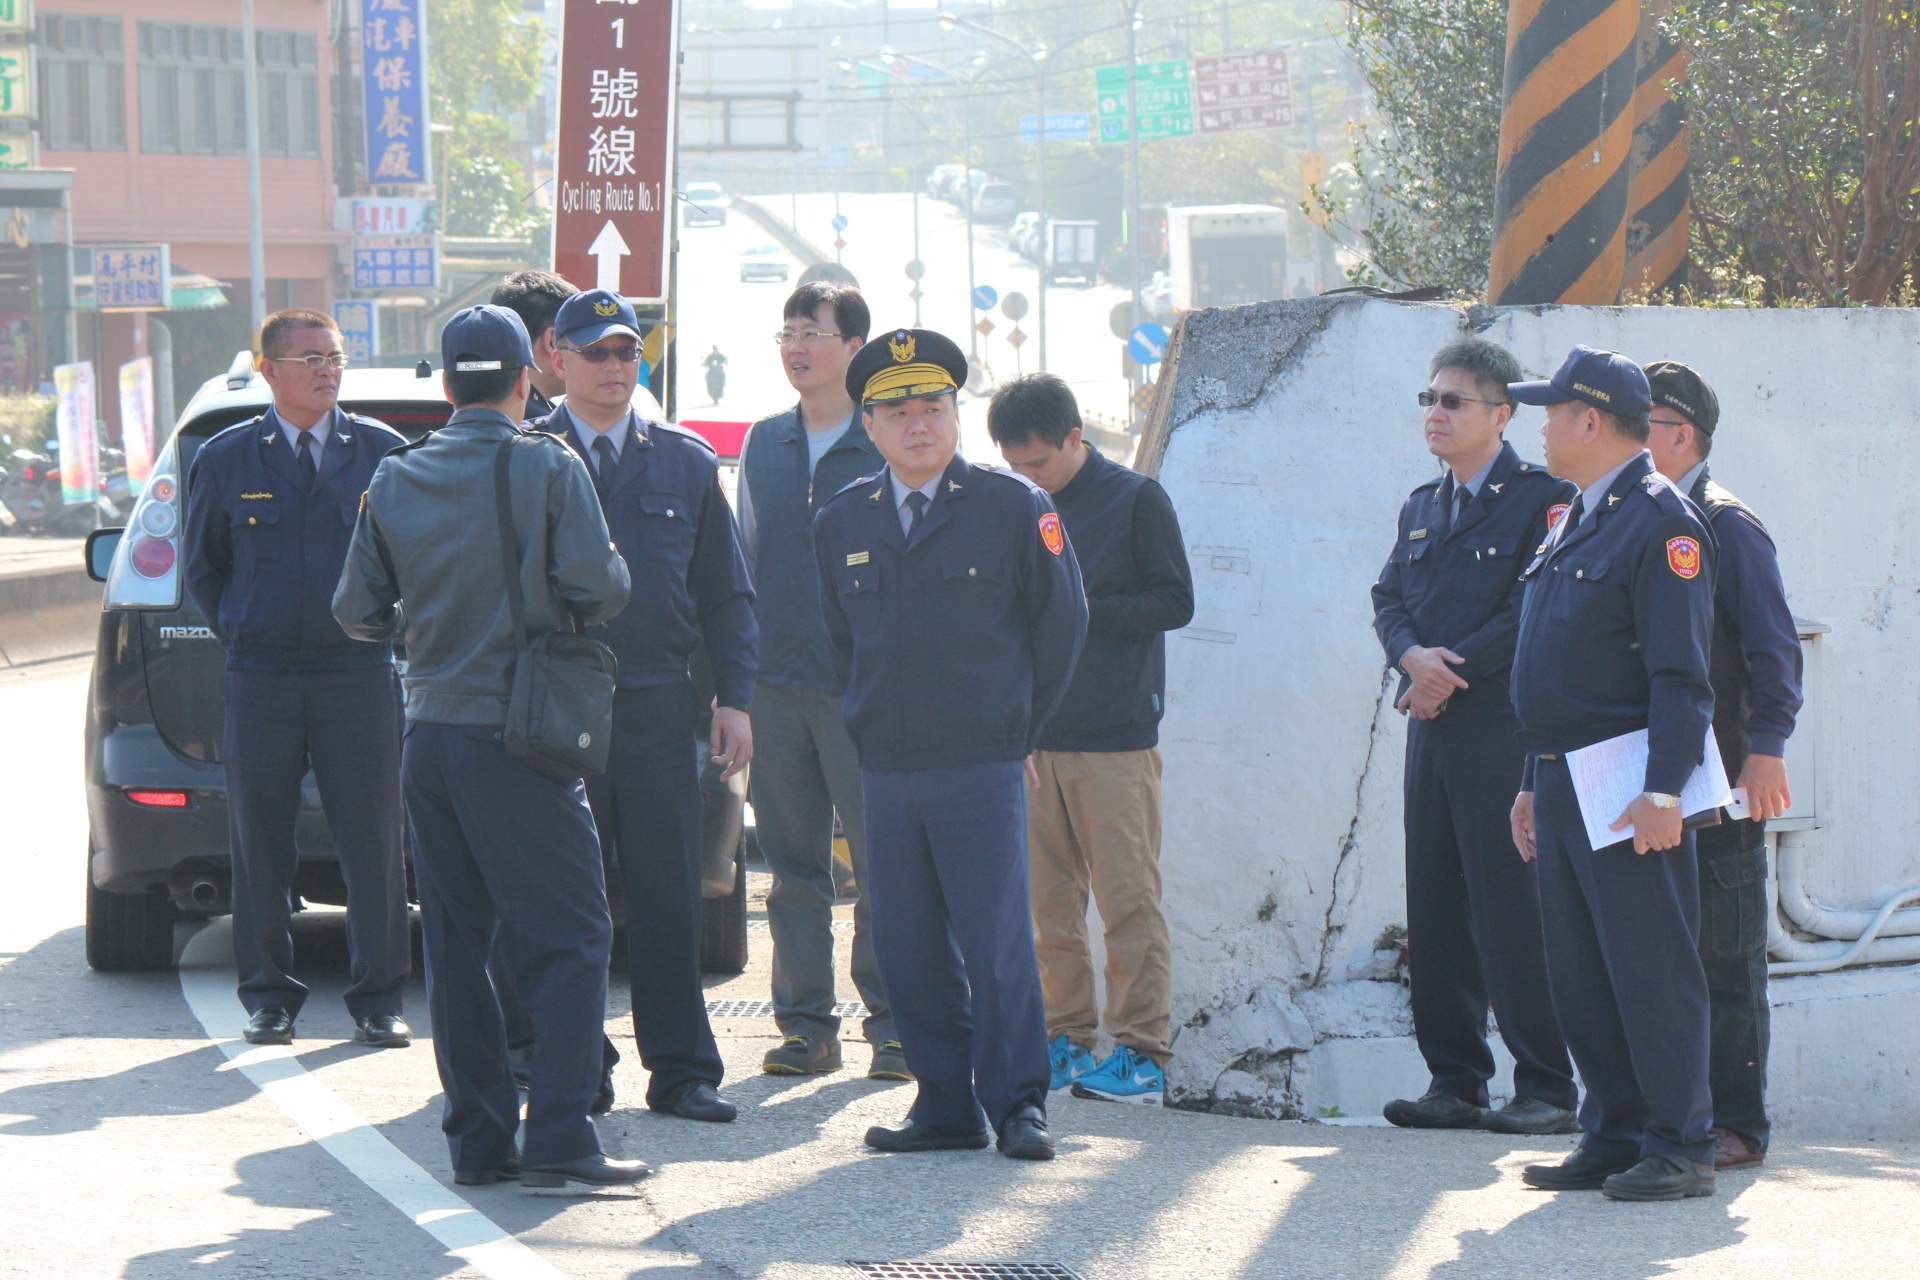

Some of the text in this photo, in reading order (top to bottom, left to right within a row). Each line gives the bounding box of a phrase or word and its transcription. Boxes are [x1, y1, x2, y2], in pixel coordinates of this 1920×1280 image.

[1273, 56, 1283, 70] 4
[588, 0, 639, 176] 1號線
[1272, 82, 1288, 96] 42
[1173, 91, 1188, 105] 11
[1274, 107, 1290, 122] 75
[1175, 118, 1191, 131] 12
[562, 180, 660, 214] Cycling Route No.1
[99, 252, 157, 278] 高平村
